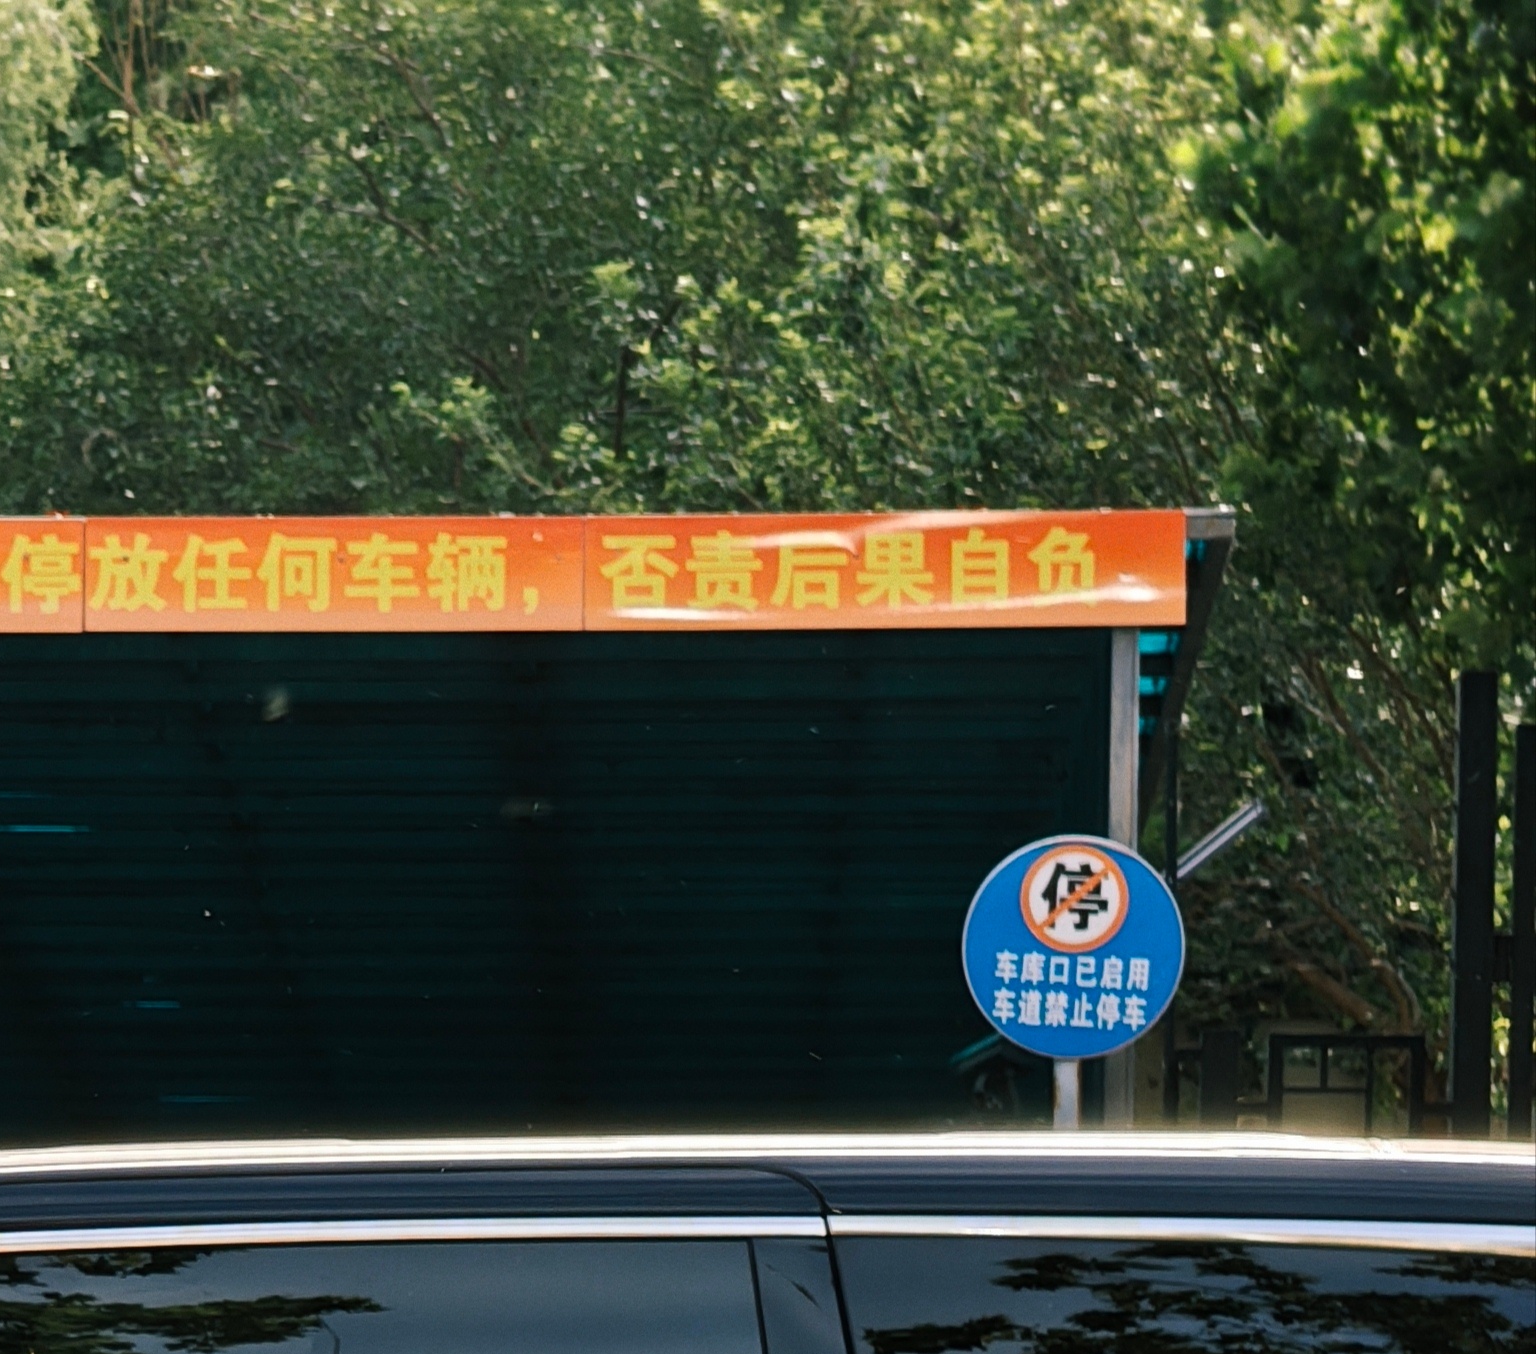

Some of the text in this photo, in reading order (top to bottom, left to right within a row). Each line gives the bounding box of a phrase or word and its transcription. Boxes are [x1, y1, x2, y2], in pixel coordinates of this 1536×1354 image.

[1041, 862, 1109, 930] 停
[995, 949, 1150, 990] 车库口已启用
[993, 988, 1147, 1031] 车道禁止停车
